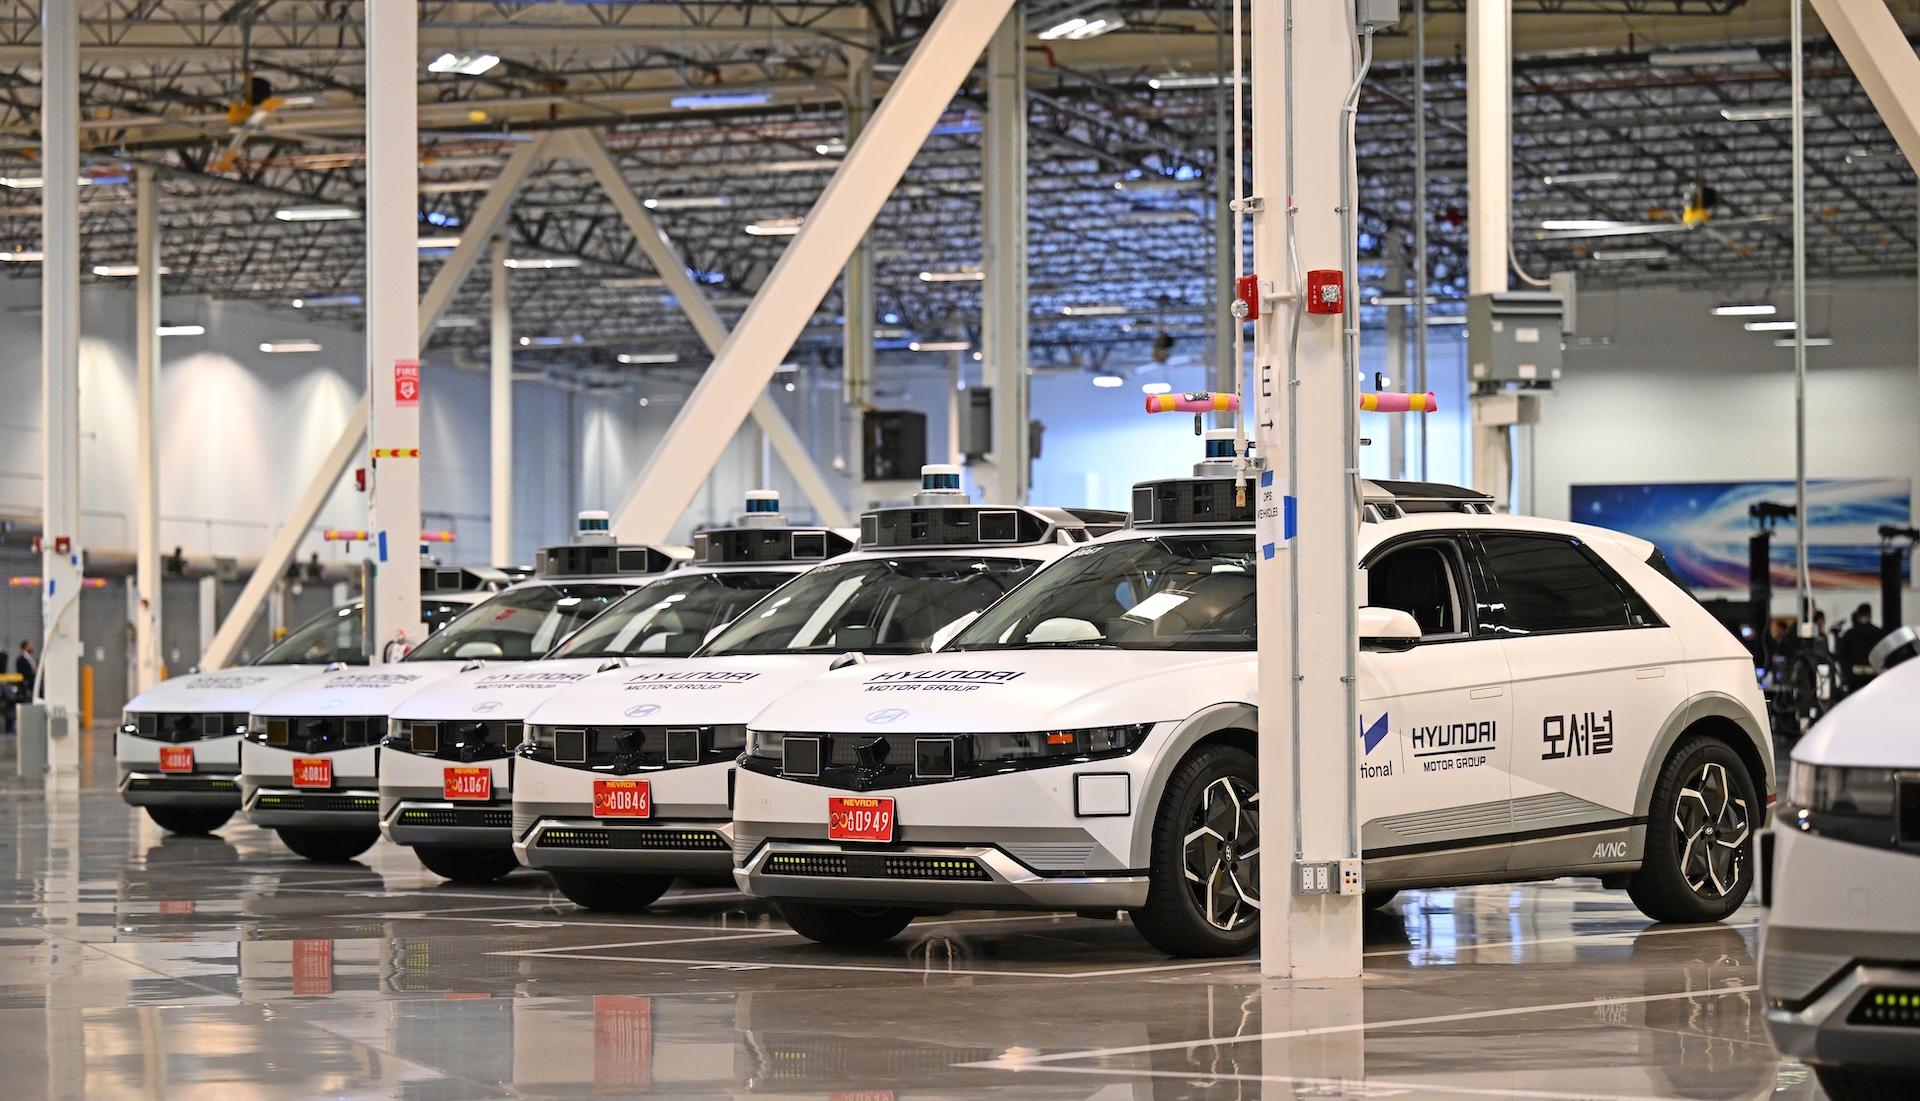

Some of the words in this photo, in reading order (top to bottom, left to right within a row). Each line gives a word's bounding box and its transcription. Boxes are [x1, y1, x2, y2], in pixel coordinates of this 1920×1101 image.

[397, 368, 417, 377] FIRE
[1262, 366, 1271, 397] E
[1263, 491, 1273, 502] OPS
[480, 673, 592, 682] HYUNDAI
[630, 672, 762, 682] HYUNDAI
[870, 670, 1026, 681] HYUNDAI
[864, 684, 921, 692] MOTOR
[922, 684, 980, 692] GROUP
[1412, 720, 1496, 749] HYUNDAI
[1541, 710, 1614, 761] 모셔널
[1360, 760, 1393, 779] tional
[1423, 760, 1454, 773] MOTOR
[1456, 756, 1486, 769] GROUP
[843, 799, 879, 807] NEVADA
[1592, 841, 1627, 859] AVNC
